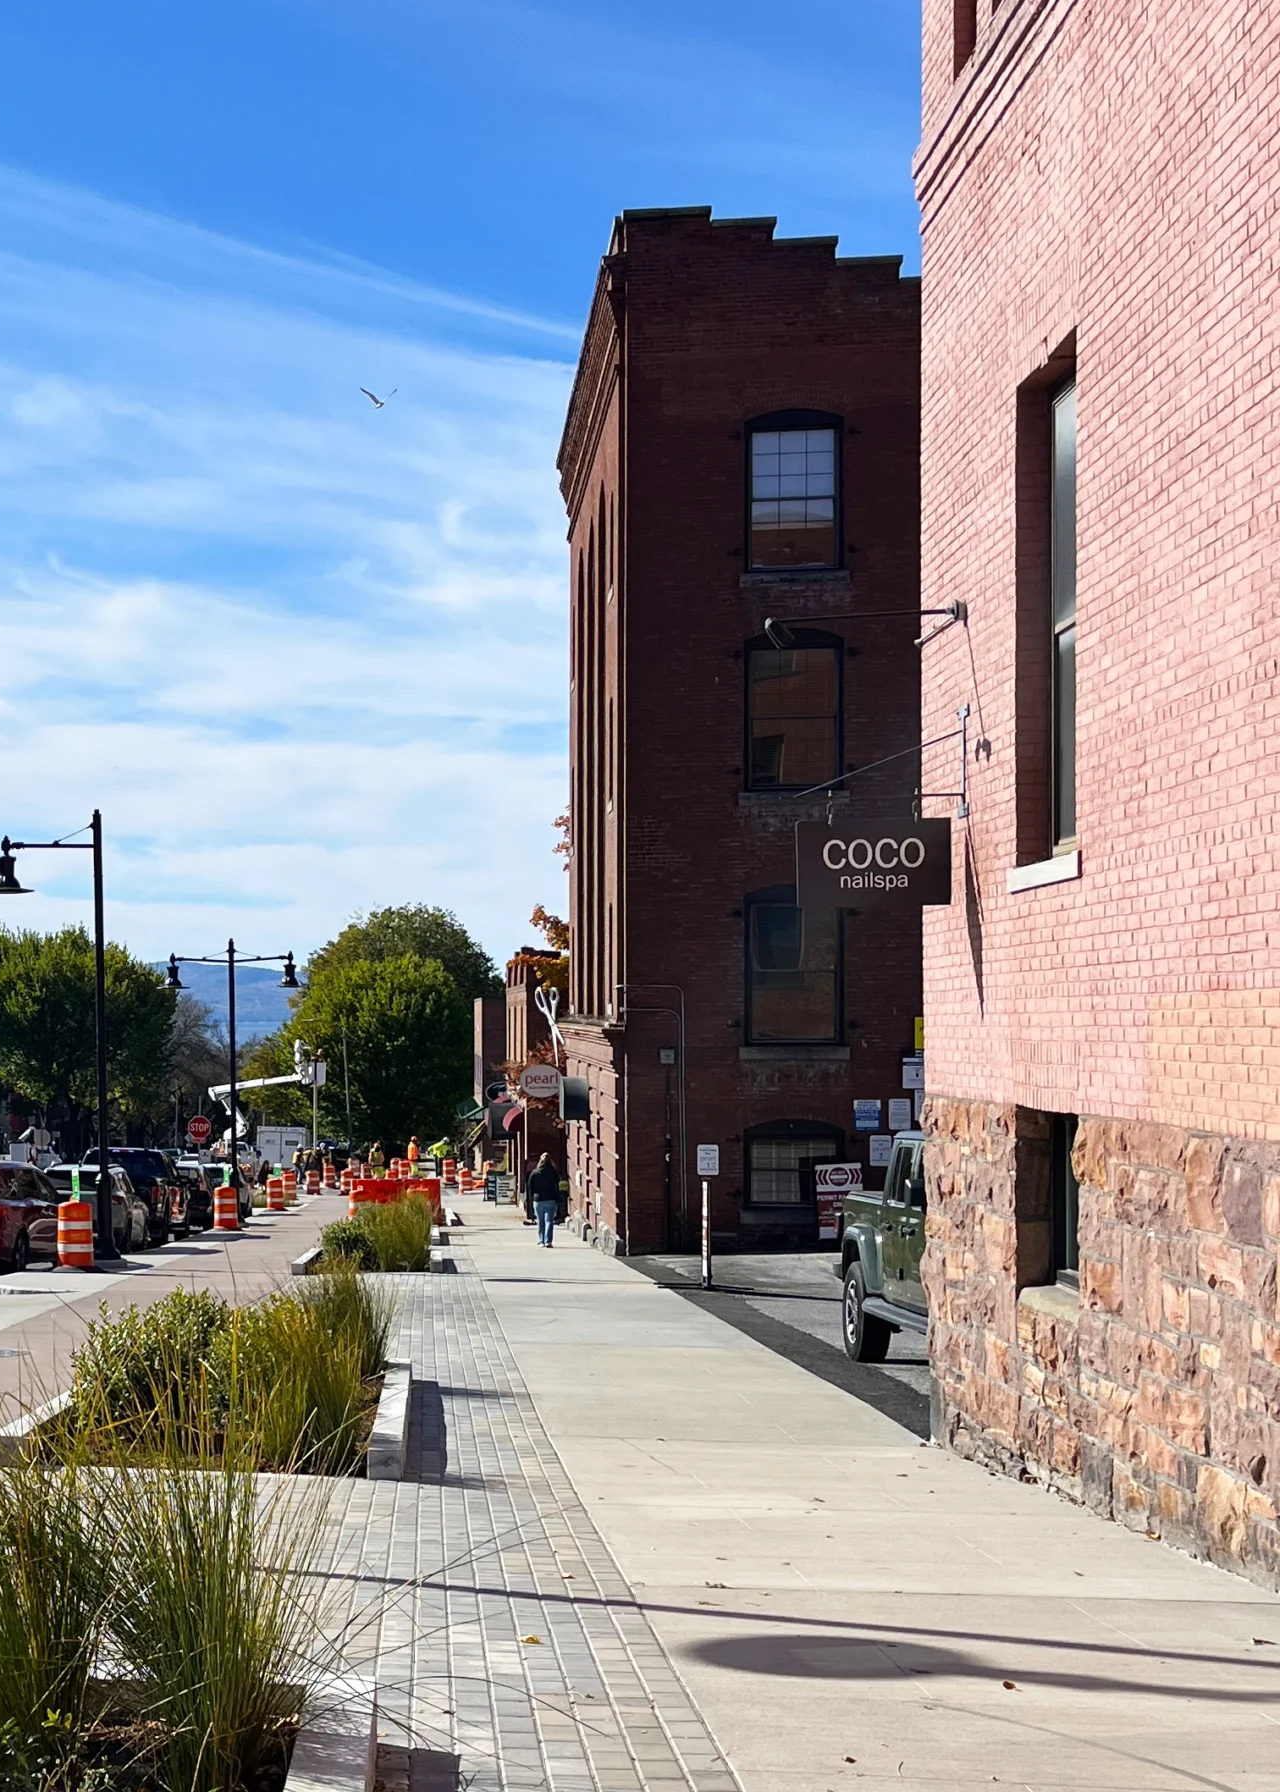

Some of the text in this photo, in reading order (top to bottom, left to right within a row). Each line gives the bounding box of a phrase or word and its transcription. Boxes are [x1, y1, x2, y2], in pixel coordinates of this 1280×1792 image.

[822, 837, 926, 870] COCO
[840, 871, 909, 892] nailspa
[525, 1071, 559, 1087] pearl
[190, 1123, 209, 1132] STOP
